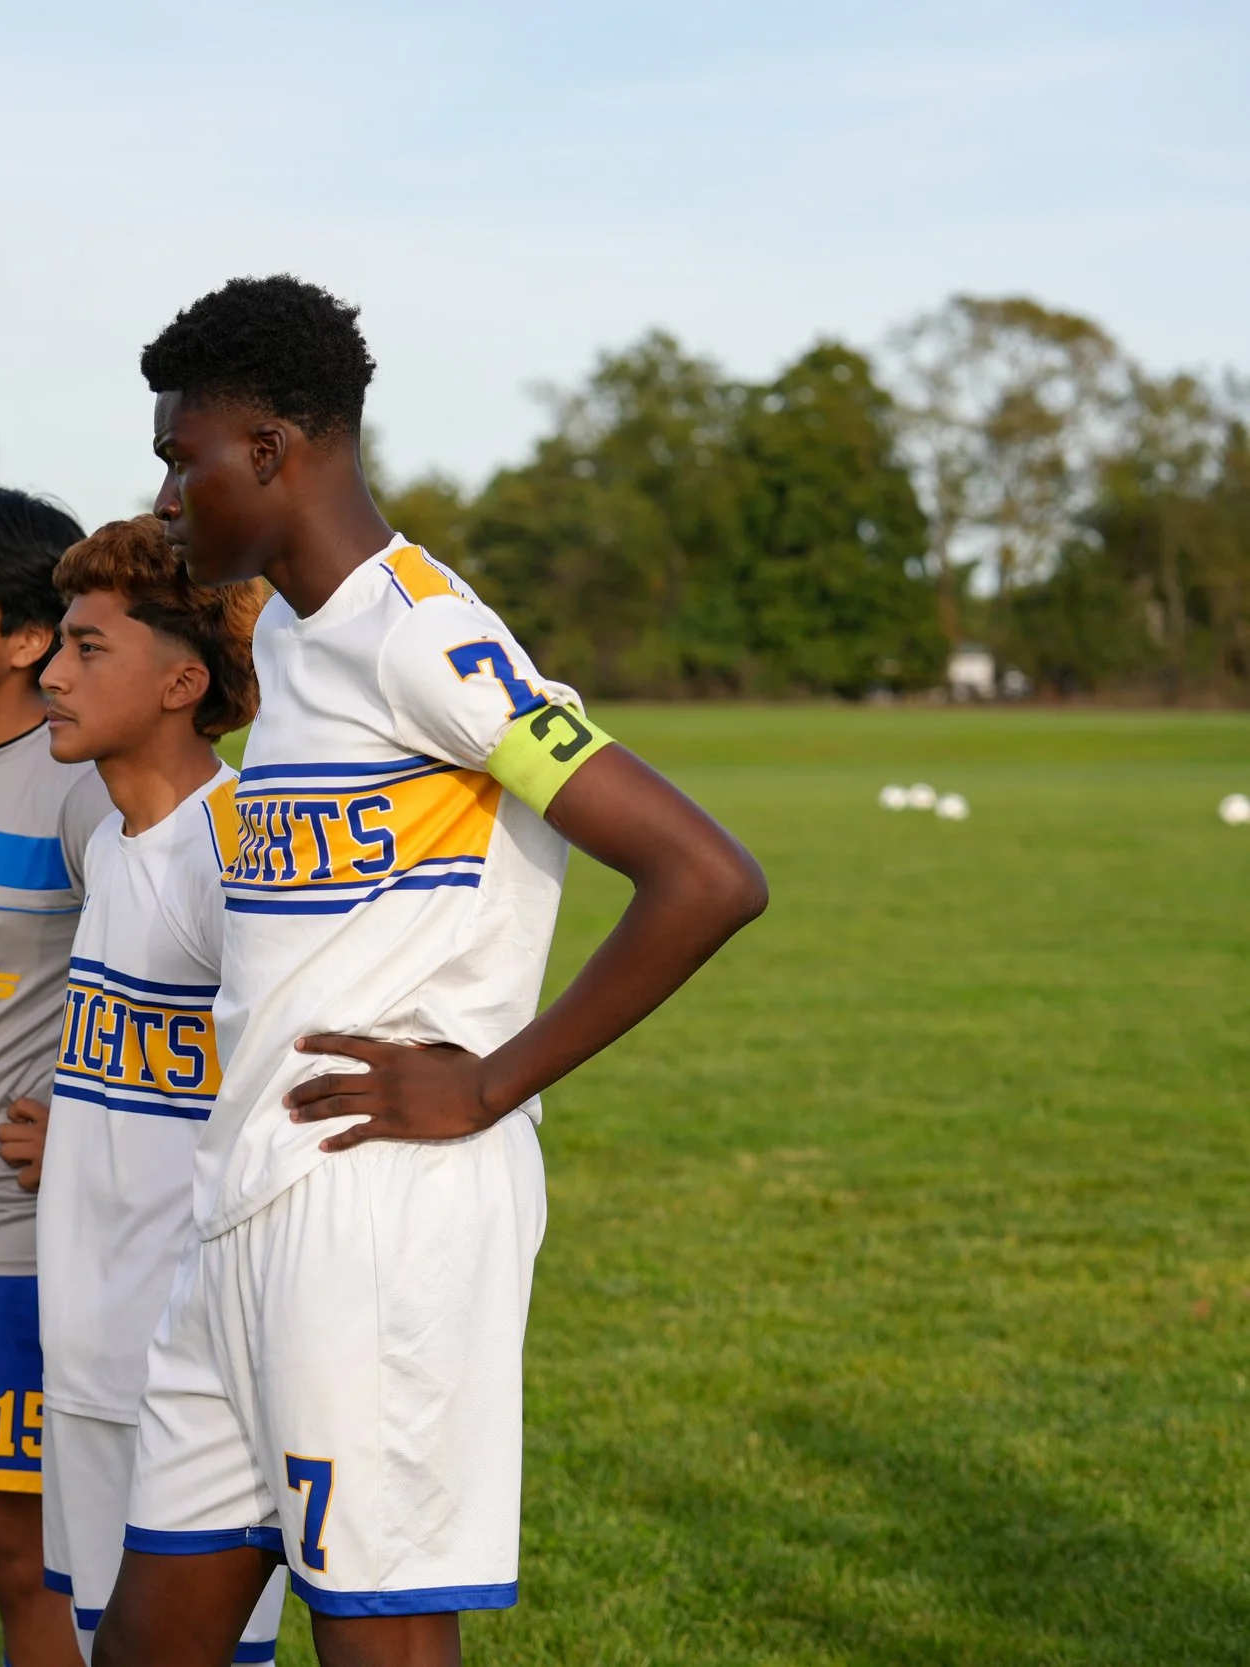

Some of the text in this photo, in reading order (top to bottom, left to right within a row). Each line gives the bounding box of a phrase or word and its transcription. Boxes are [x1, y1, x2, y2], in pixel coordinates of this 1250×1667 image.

[443, 639, 551, 721] 7
[529, 704, 593, 763] C
[225, 794, 395, 882] IGHTS
[57, 988, 207, 1090] IGHTS
[283, 1450, 335, 1573] 7
